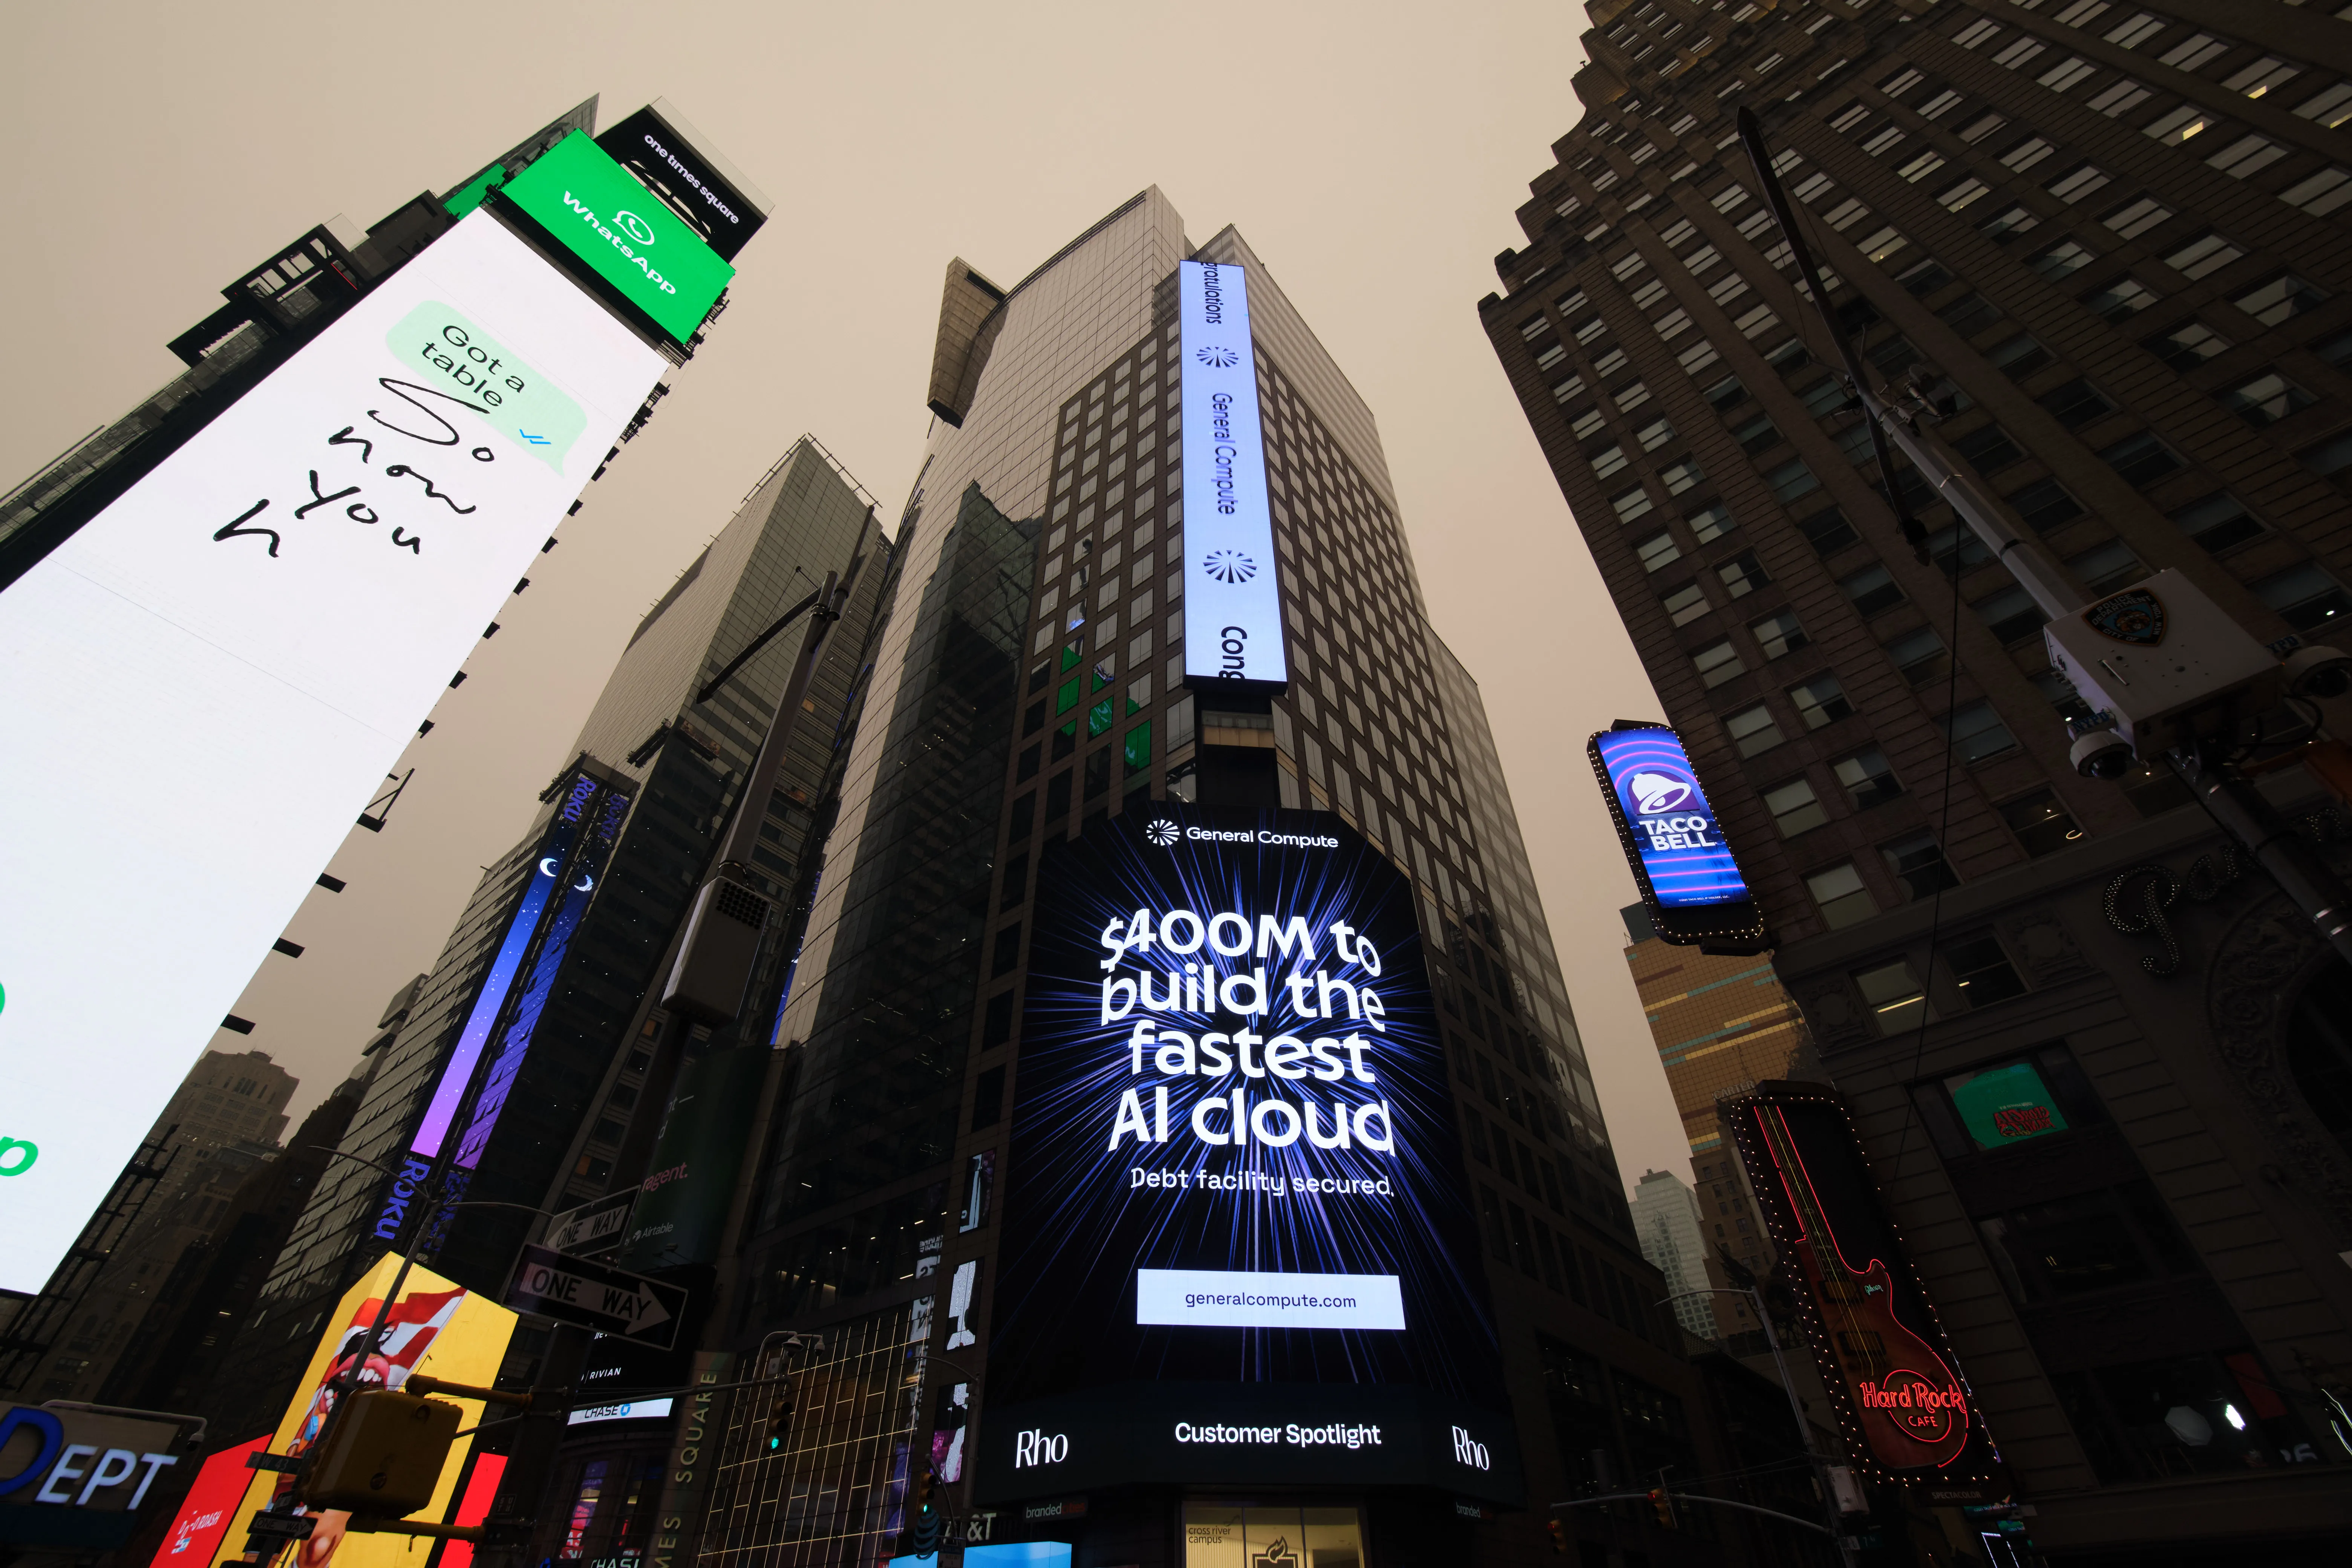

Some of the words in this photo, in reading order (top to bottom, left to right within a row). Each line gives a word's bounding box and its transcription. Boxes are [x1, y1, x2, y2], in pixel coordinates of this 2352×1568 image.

[644, 135, 668, 158] one
[667, 153, 701, 189] times
[699, 184, 739, 225] square
[563, 190, 676, 295] WhatsApp
[442, 325, 502, 375] Got
[505, 375, 525, 393] a
[421, 341, 503, 407] table
[1212, 393, 1236, 443] General
[1211, 445, 1238, 516] Compute
[2092, 595, 2151, 626] DEPARTMENT
[2096, 594, 2132, 613] POLICE
[2150, 602, 2162, 619] YORK
[2102, 628, 2123, 639] CITY
[2152, 621, 2163, 635] NEW
[2265, 635, 2299, 654] YPD
[2072, 710, 2111, 733] NYPD
[1187, 827, 1254, 842] General
[1258, 831, 1338, 848] Compute
[1638, 816, 1707, 835] TACO
[1650, 832, 1717, 851] BELL
[1101, 908, 1316, 973] $400M
[1329, 919, 1381, 977] to
[1101, 962, 1268, 1026] build
[1285, 970, 1385, 1032] the
[1128, 1020, 1375, 1083] fastest
[1713, 1080, 1755, 1099] CARTER
[1108, 1086, 1168, 1152] AI
[1191, 1087, 1395, 1157] cloud
[1131, 1167, 1188, 1188] Debt
[1196, 1168, 1284, 1196] facility
[1293, 1175, 1394, 1197] secured.
[556, 1222, 583, 1247] ONE
[590, 1208, 623, 1237] WAY
[642, 1222, 673, 1239] Airtable
[531, 1269, 582, 1303] ONE
[602, 1288, 652, 1320] WAY
[1185, 1292, 1356, 1309] generalcompute.com
[590, 1367, 622, 1380] RIVIAN
[1859, 1382, 1912, 1408] Hard
[1912, 1382, 1967, 1413] Rock
[585, 1405, 620, 1418] CHASE
[1908, 1416, 1938, 1427] CAFE
[675, 1373, 717, 1484] SQUARE
[1175, 1423, 1282, 1443] Customer
[1286, 1424, 1382, 1449] Spotlight
[0, 1406, 180, 1511] DEPT
[1016, 1429, 1068, 1468] Rho
[1452, 1426, 1489, 1470] Rho
[260, 1455, 273, 1467] W
[275, 1458, 289, 1471] 43
[1931, 1490, 1982, 1500] SPECTACOLOR
[256, 1518, 276, 1529] ONE
[286, 1522, 308, 1531] WAY
[943, 1512, 997, 1545] &T
[1212, 1526, 1231, 1535] river
[1188, 1535, 1222, 1545] campus
